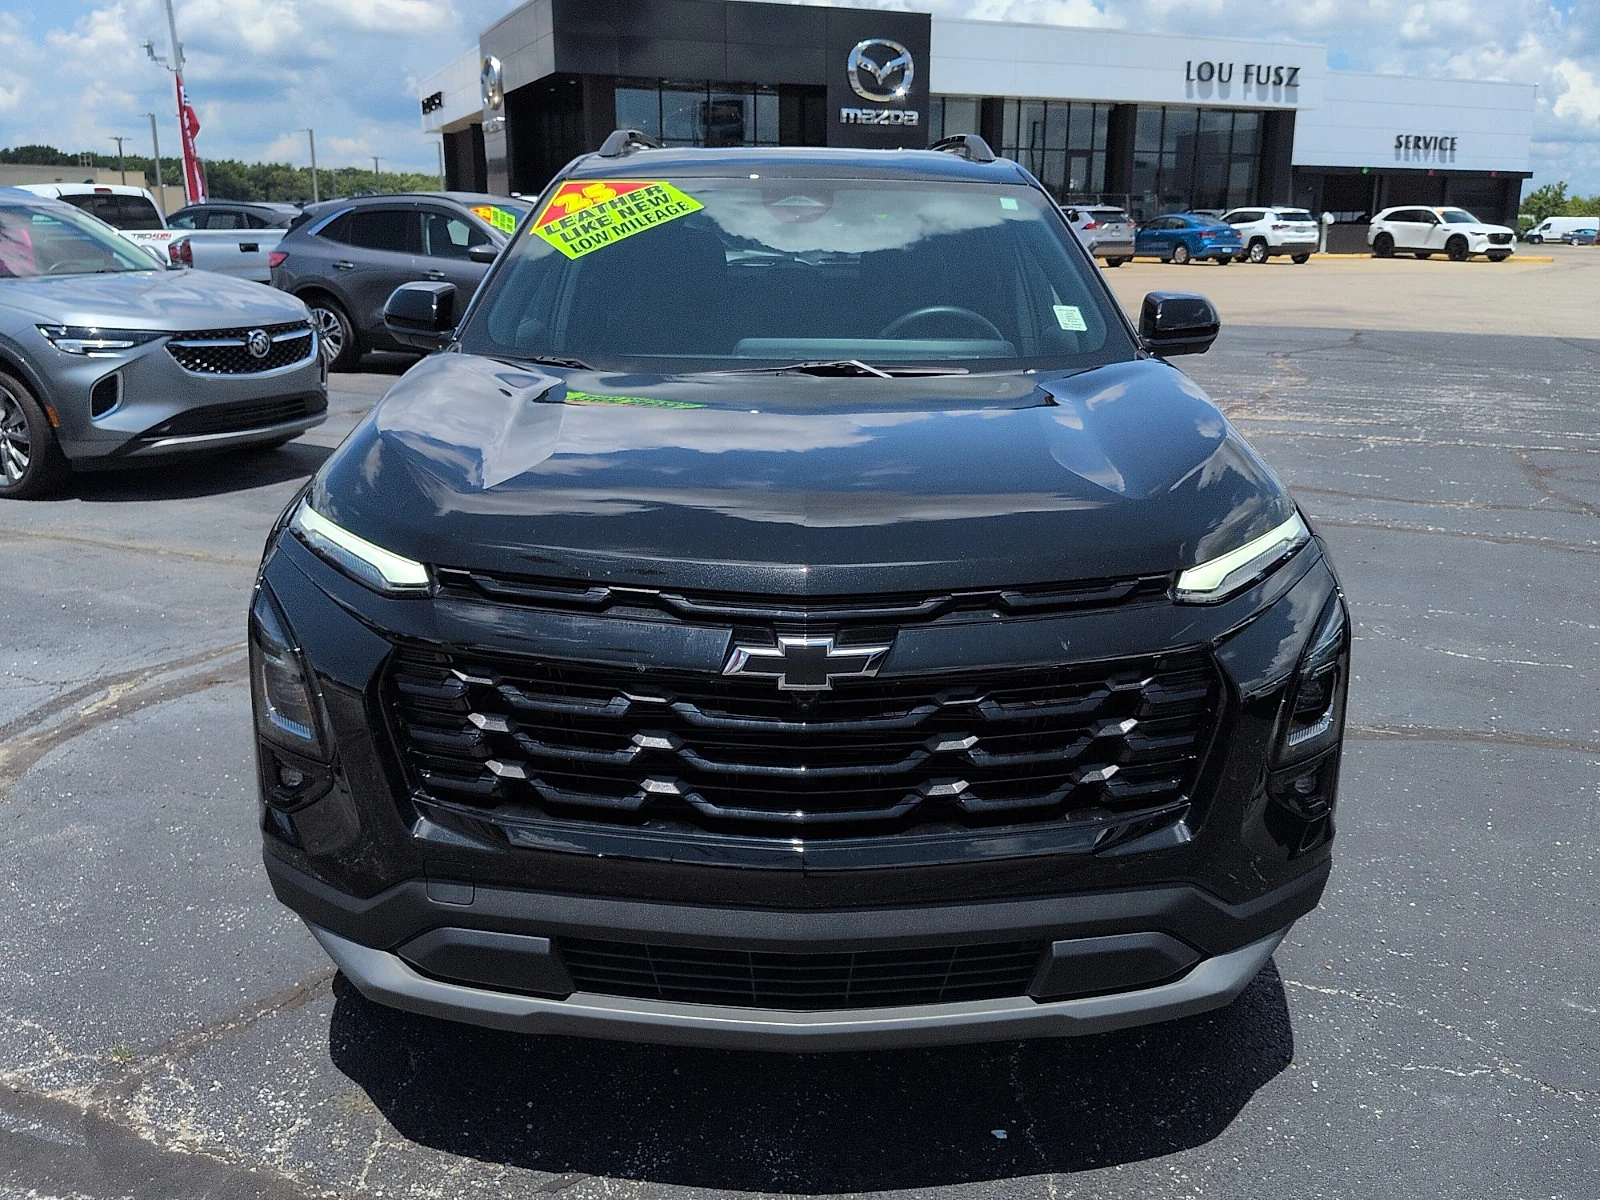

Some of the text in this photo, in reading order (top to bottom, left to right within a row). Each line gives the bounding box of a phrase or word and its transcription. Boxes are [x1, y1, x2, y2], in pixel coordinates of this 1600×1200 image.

[1185, 60, 1300, 87] LOU FUSZ
[1394, 134, 1458, 151] SERVICE
[543, 184, 664, 237] LEATHER
[552, 182, 617, 214] 25
[559, 192, 672, 244] LIKE NEW
[569, 200, 690, 255] LOW MILEAGE
